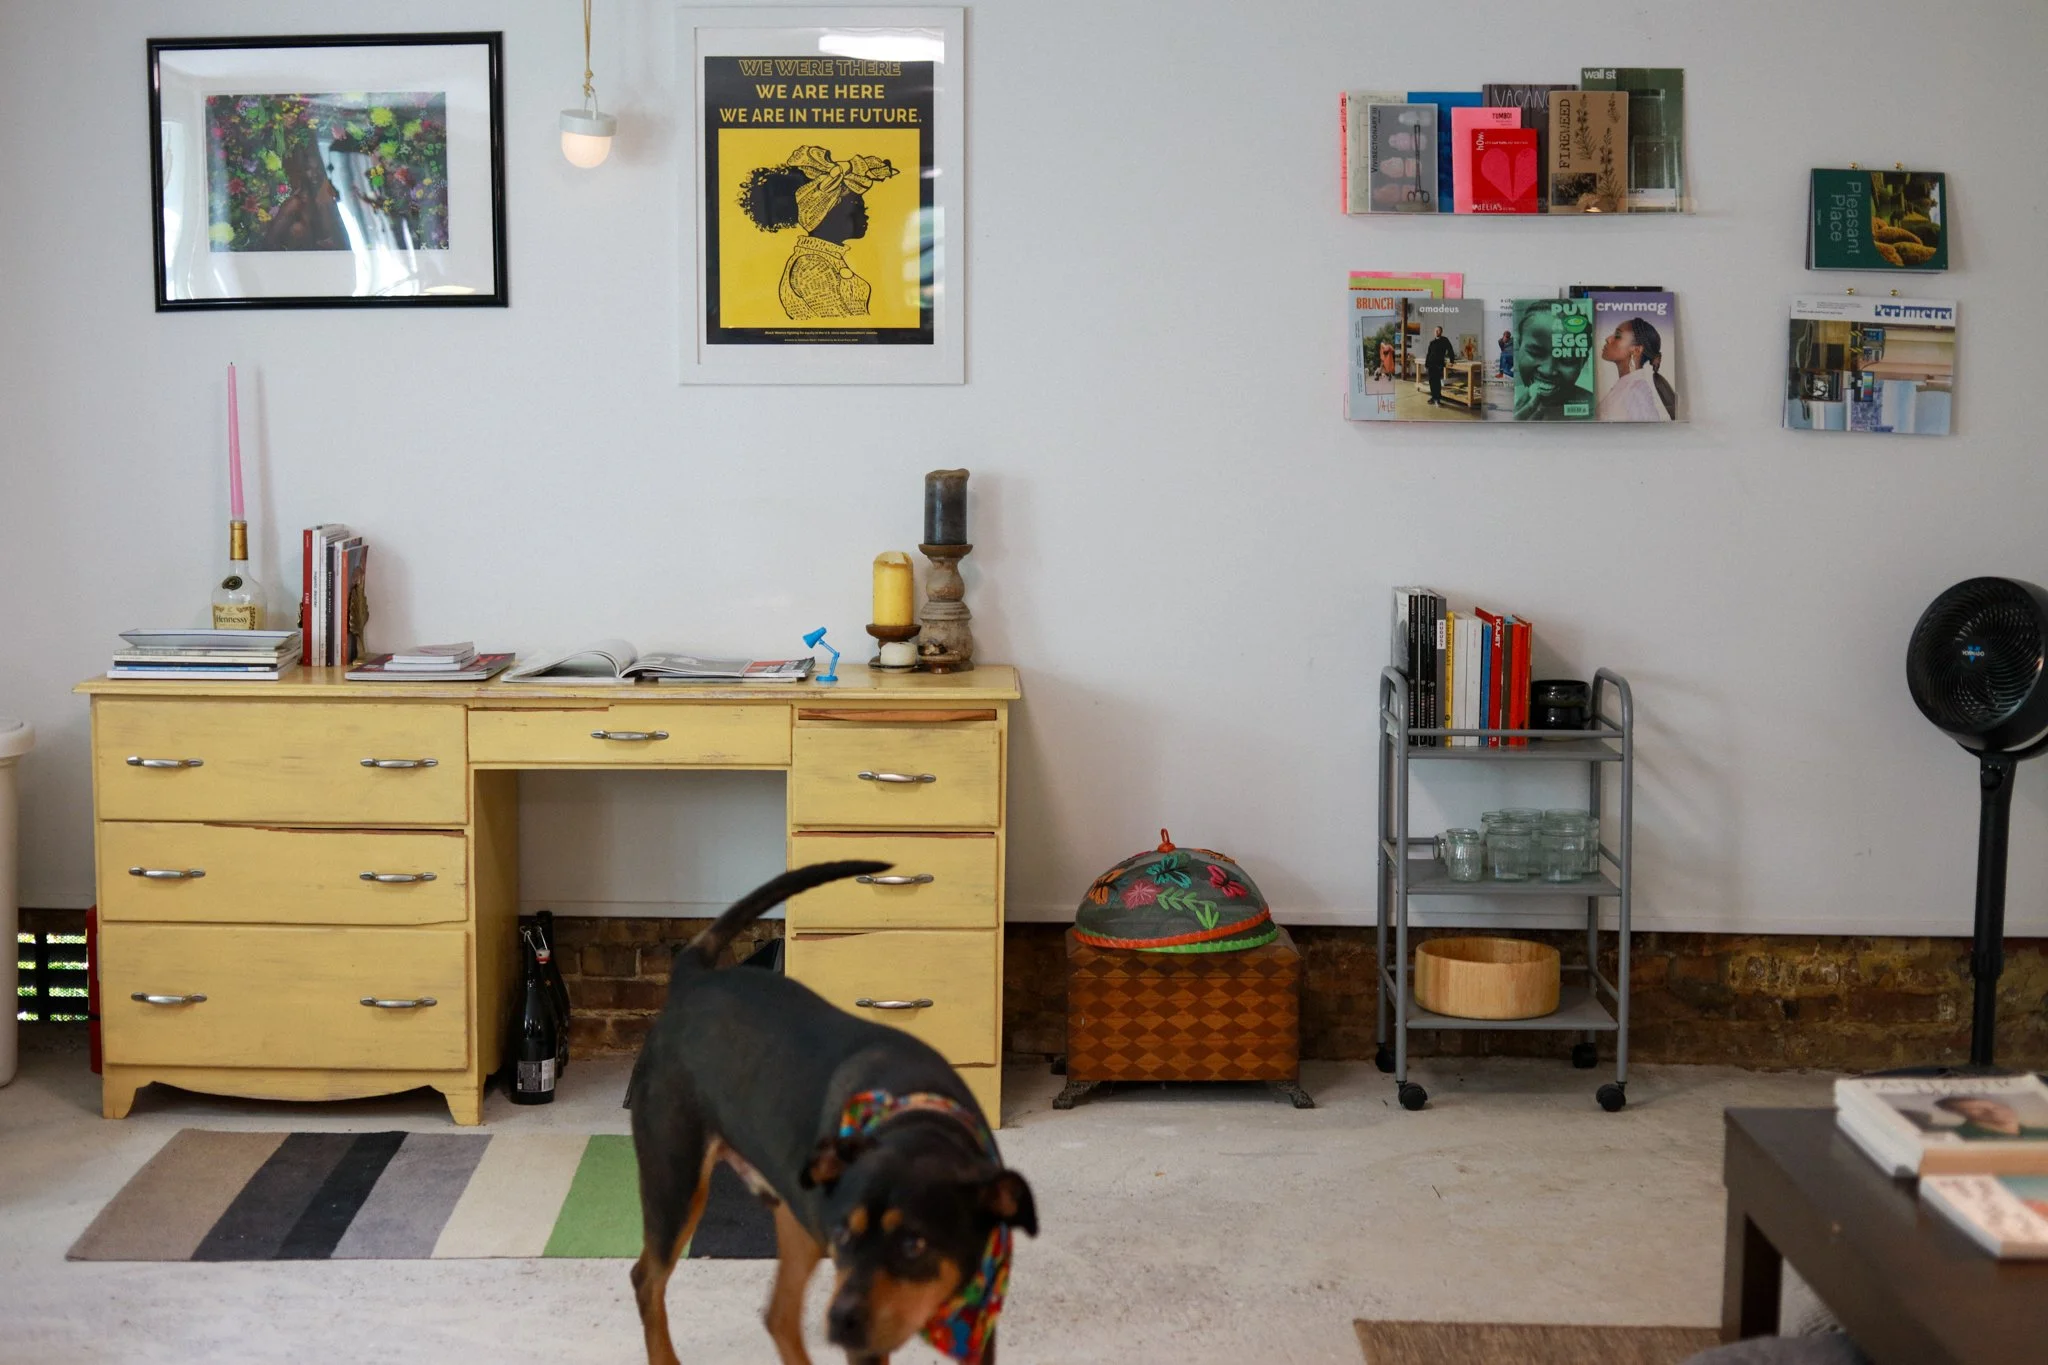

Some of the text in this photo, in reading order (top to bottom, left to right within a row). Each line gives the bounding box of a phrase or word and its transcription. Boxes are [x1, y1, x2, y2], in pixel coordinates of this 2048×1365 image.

[739, 60, 901, 76] WE WERE THERE
[1584, 69, 1617, 80] wall st
[756, 84, 885, 99] WE ARE HERE
[719, 108, 922, 123] WE ARE IN THE FUTURE.
[1559, 99, 1571, 169] FIREWEED
[1830, 194, 1846, 243] Place
[1846, 181, 1861, 255] Pleasant
[1419, 304, 1460, 313] amadeus
[1551, 303, 1588, 315] PUT
[1596, 302, 1668, 315] crwnmag
[1552, 334, 1588, 347] EGG
[1552, 347, 1588, 358] ON IT
[216, 614, 248, 625] Hennessy
